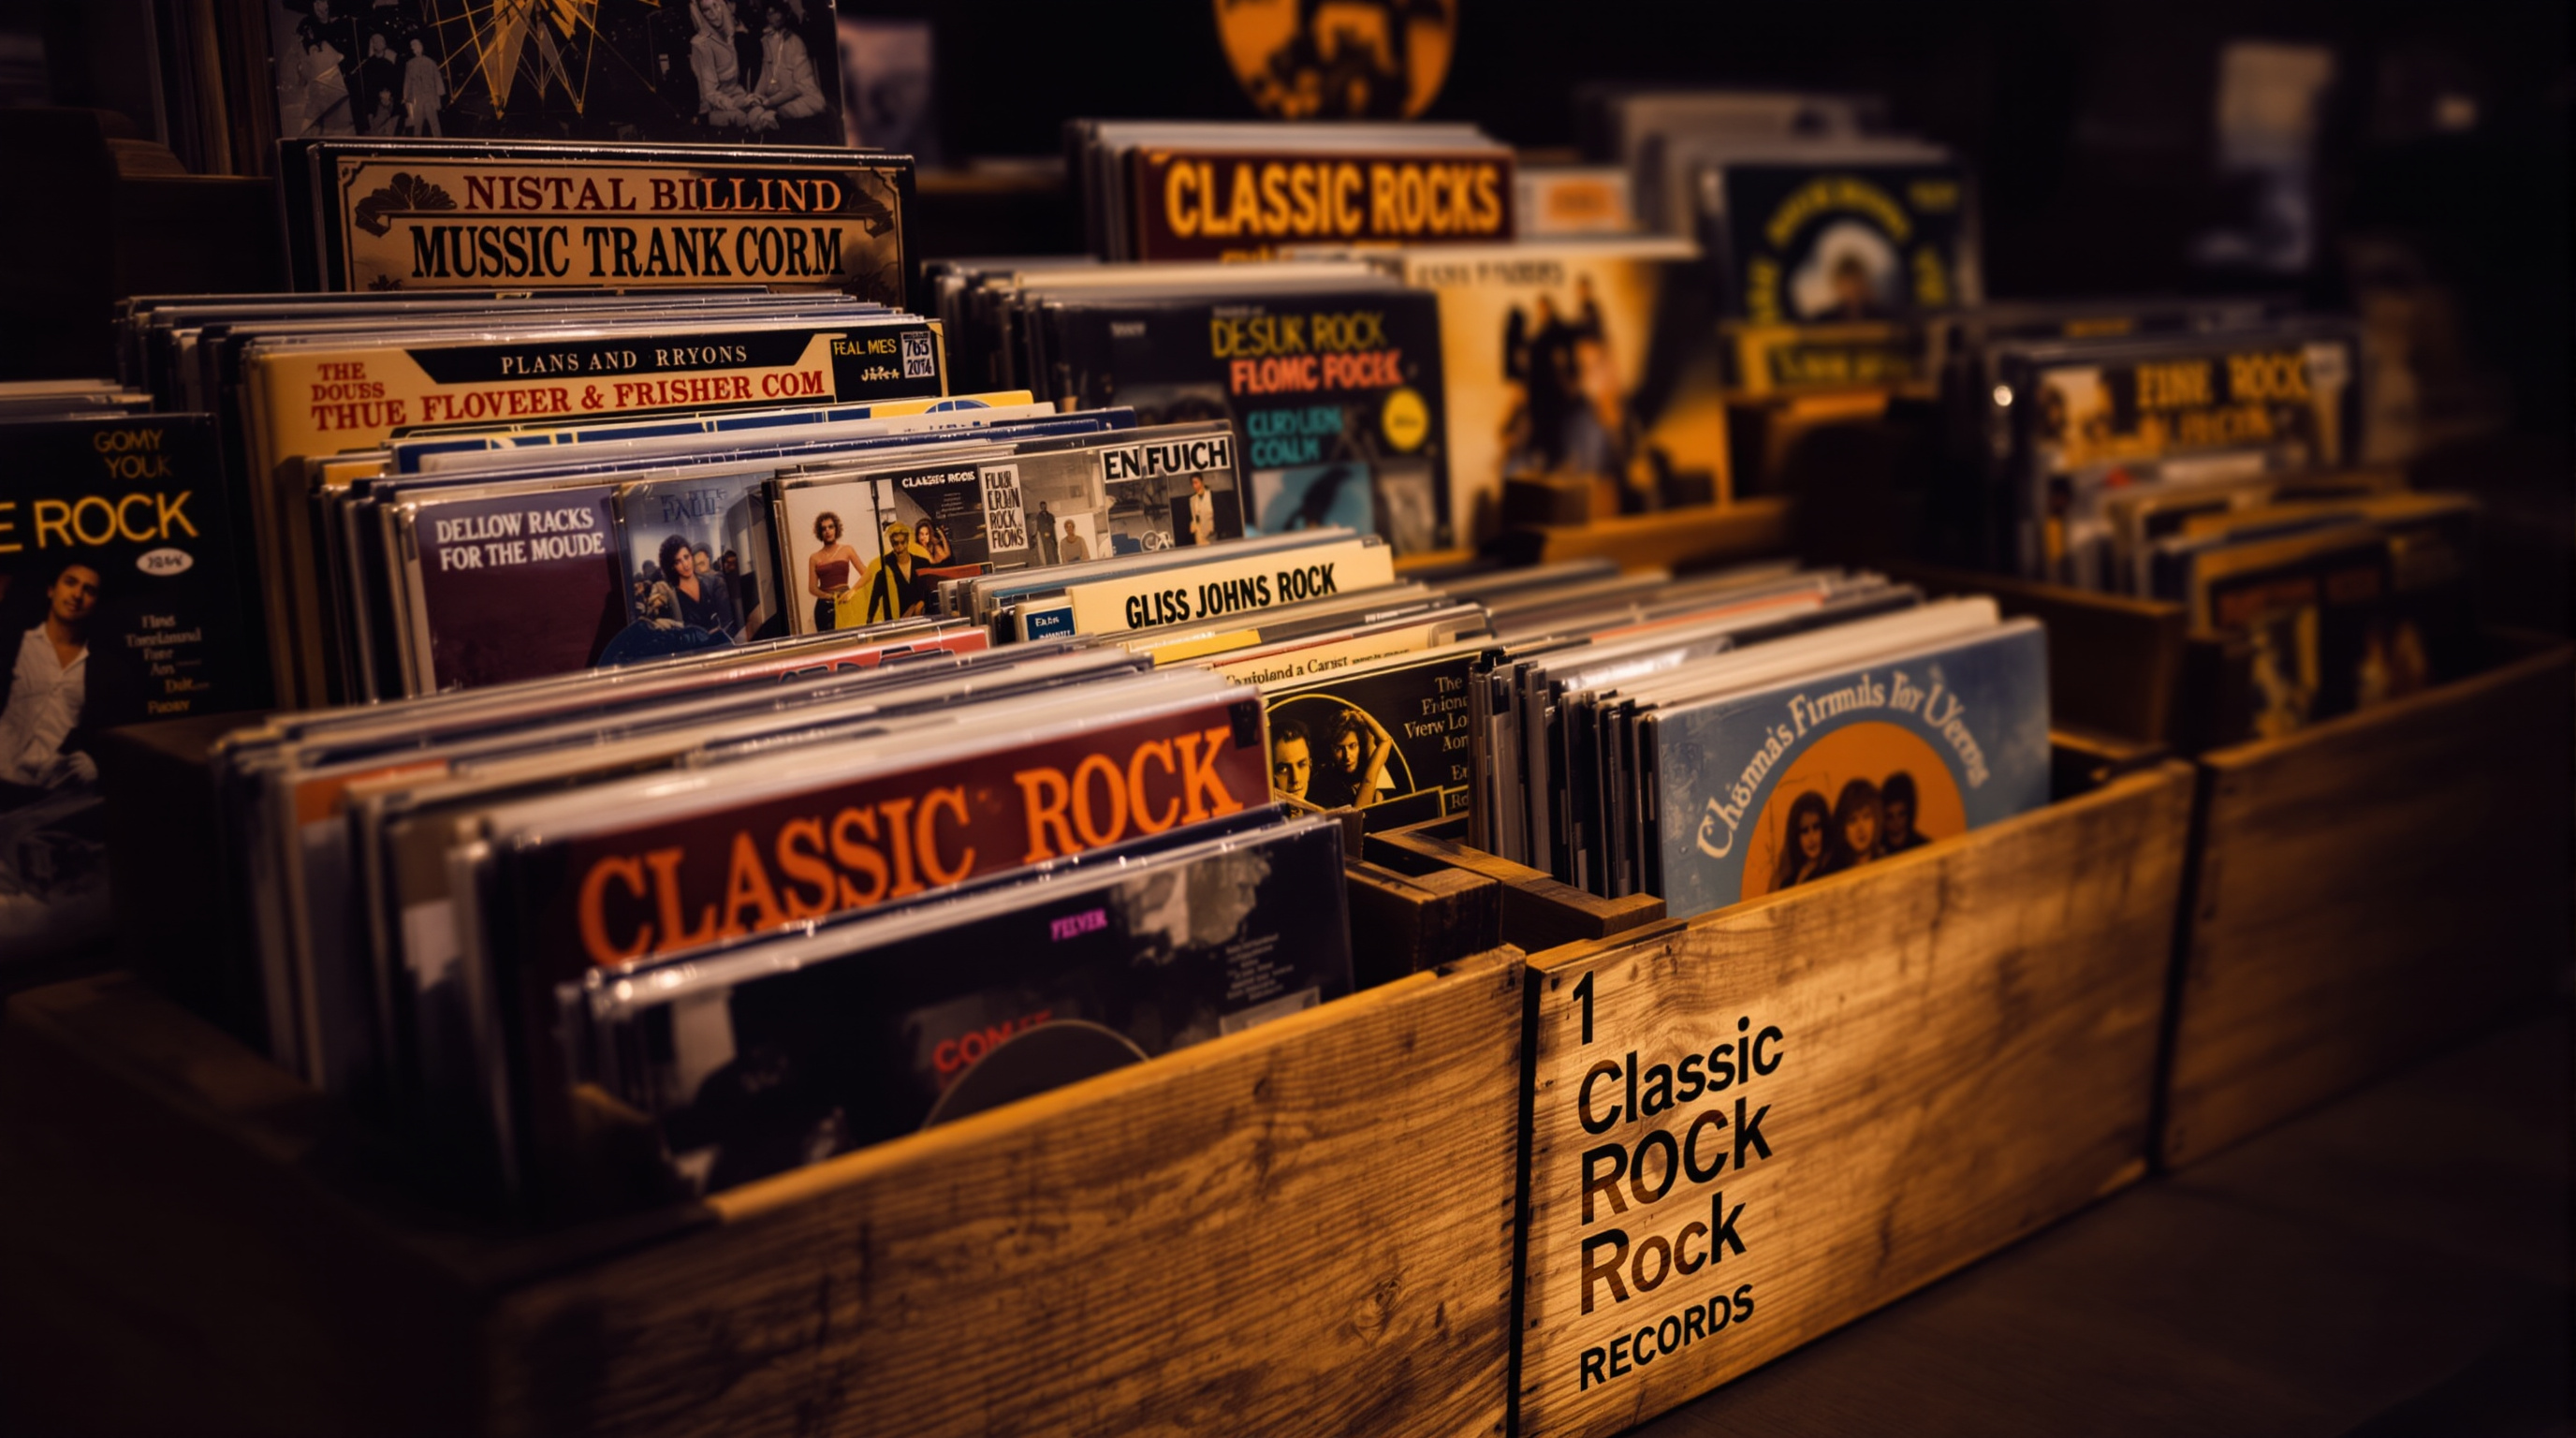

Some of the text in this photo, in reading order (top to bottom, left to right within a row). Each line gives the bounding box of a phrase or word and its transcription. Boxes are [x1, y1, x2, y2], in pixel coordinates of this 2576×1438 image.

[464, 175, 842, 213] NISTAL BILLIND
[1165, 160, 1363, 236] CLASSIC
[1369, 164, 1501, 232] ROCKS
[409, 226, 846, 278] MUSSIC TRANK CORM
[318, 362, 366, 382] THE
[501, 345, 747, 374] PLANS AND RRYONS
[311, 382, 386, 402] DOUSS
[311, 400, 407, 432] THUE
[420, 387, 572, 422] FLOVEER
[580, 385, 604, 410] &
[615, 373, 754, 408] FRISHER
[761, 371, 825, 397] COM
[1104, 440, 1229, 480] EN FUICH
[34, 491, 198, 549] ROCK
[436, 507, 594, 544] DELLOW RACKS
[989, 509, 1017, 529] ROCK
[439, 532, 606, 571] FOR THE MOUDE
[1125, 563, 1338, 630] GLISS JOHNS ROCK
[1434, 676, 1463, 693] The
[577, 725, 1244, 970] CLASSIC ROCK
[1573, 970, 1594, 1046] 1
[1577, 1016, 1784, 1136] Classic
[1580, 1191, 1748, 1316] Rock
[1579, 1283, 1755, 1392] RECORDS
